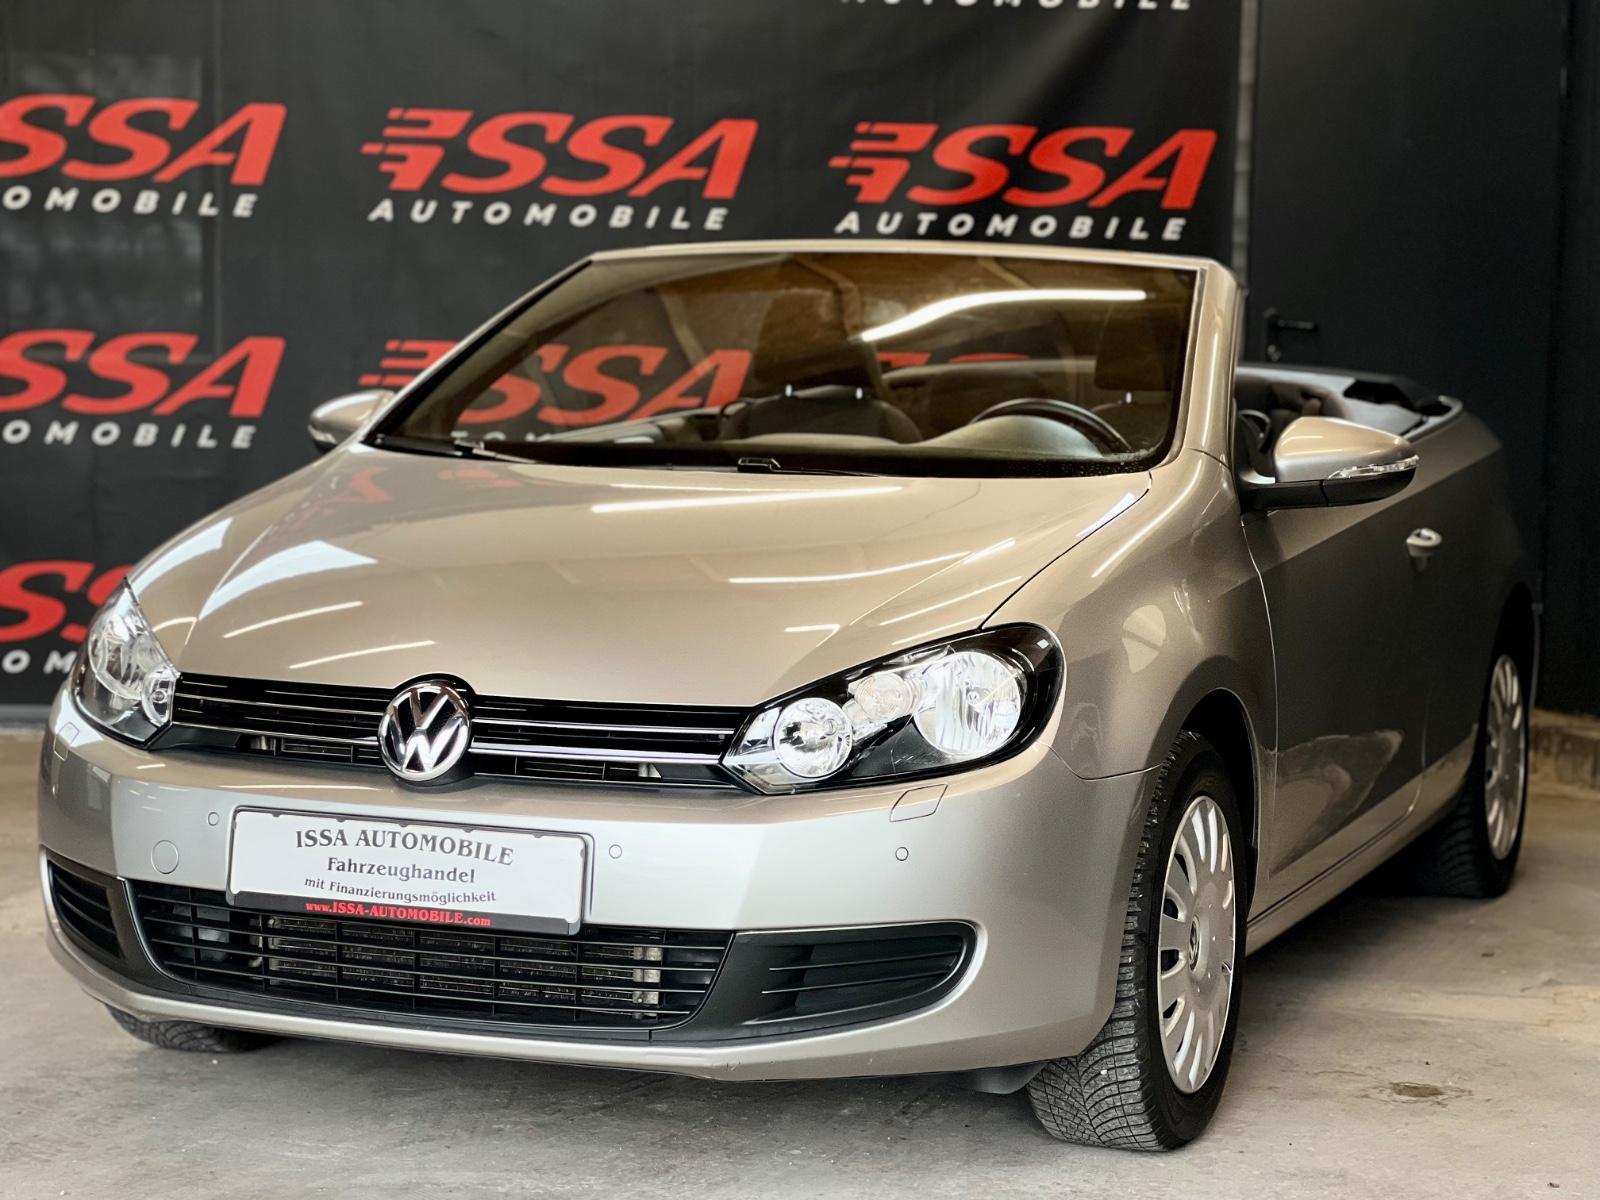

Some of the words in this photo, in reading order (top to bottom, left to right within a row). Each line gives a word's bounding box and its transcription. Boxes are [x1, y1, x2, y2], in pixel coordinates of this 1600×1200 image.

[361, 107, 758, 200] ISSA
[829, 121, 1217, 209] ISSA
[368, 198, 728, 230] AUTOMOBILE
[835, 211, 1185, 241] AUTOMOBILE
[296, 829, 348, 848] ISSA
[355, 829, 514, 866] AUTOMOBILE
[327, 857, 475, 883] Fahrzeughandel
[304, 877, 325, 890] mit
[329, 881, 497, 906] Finanzierungsmöglichkeit
[305, 901, 492, 927] www.ISSA-AUTOMOBILE.com
